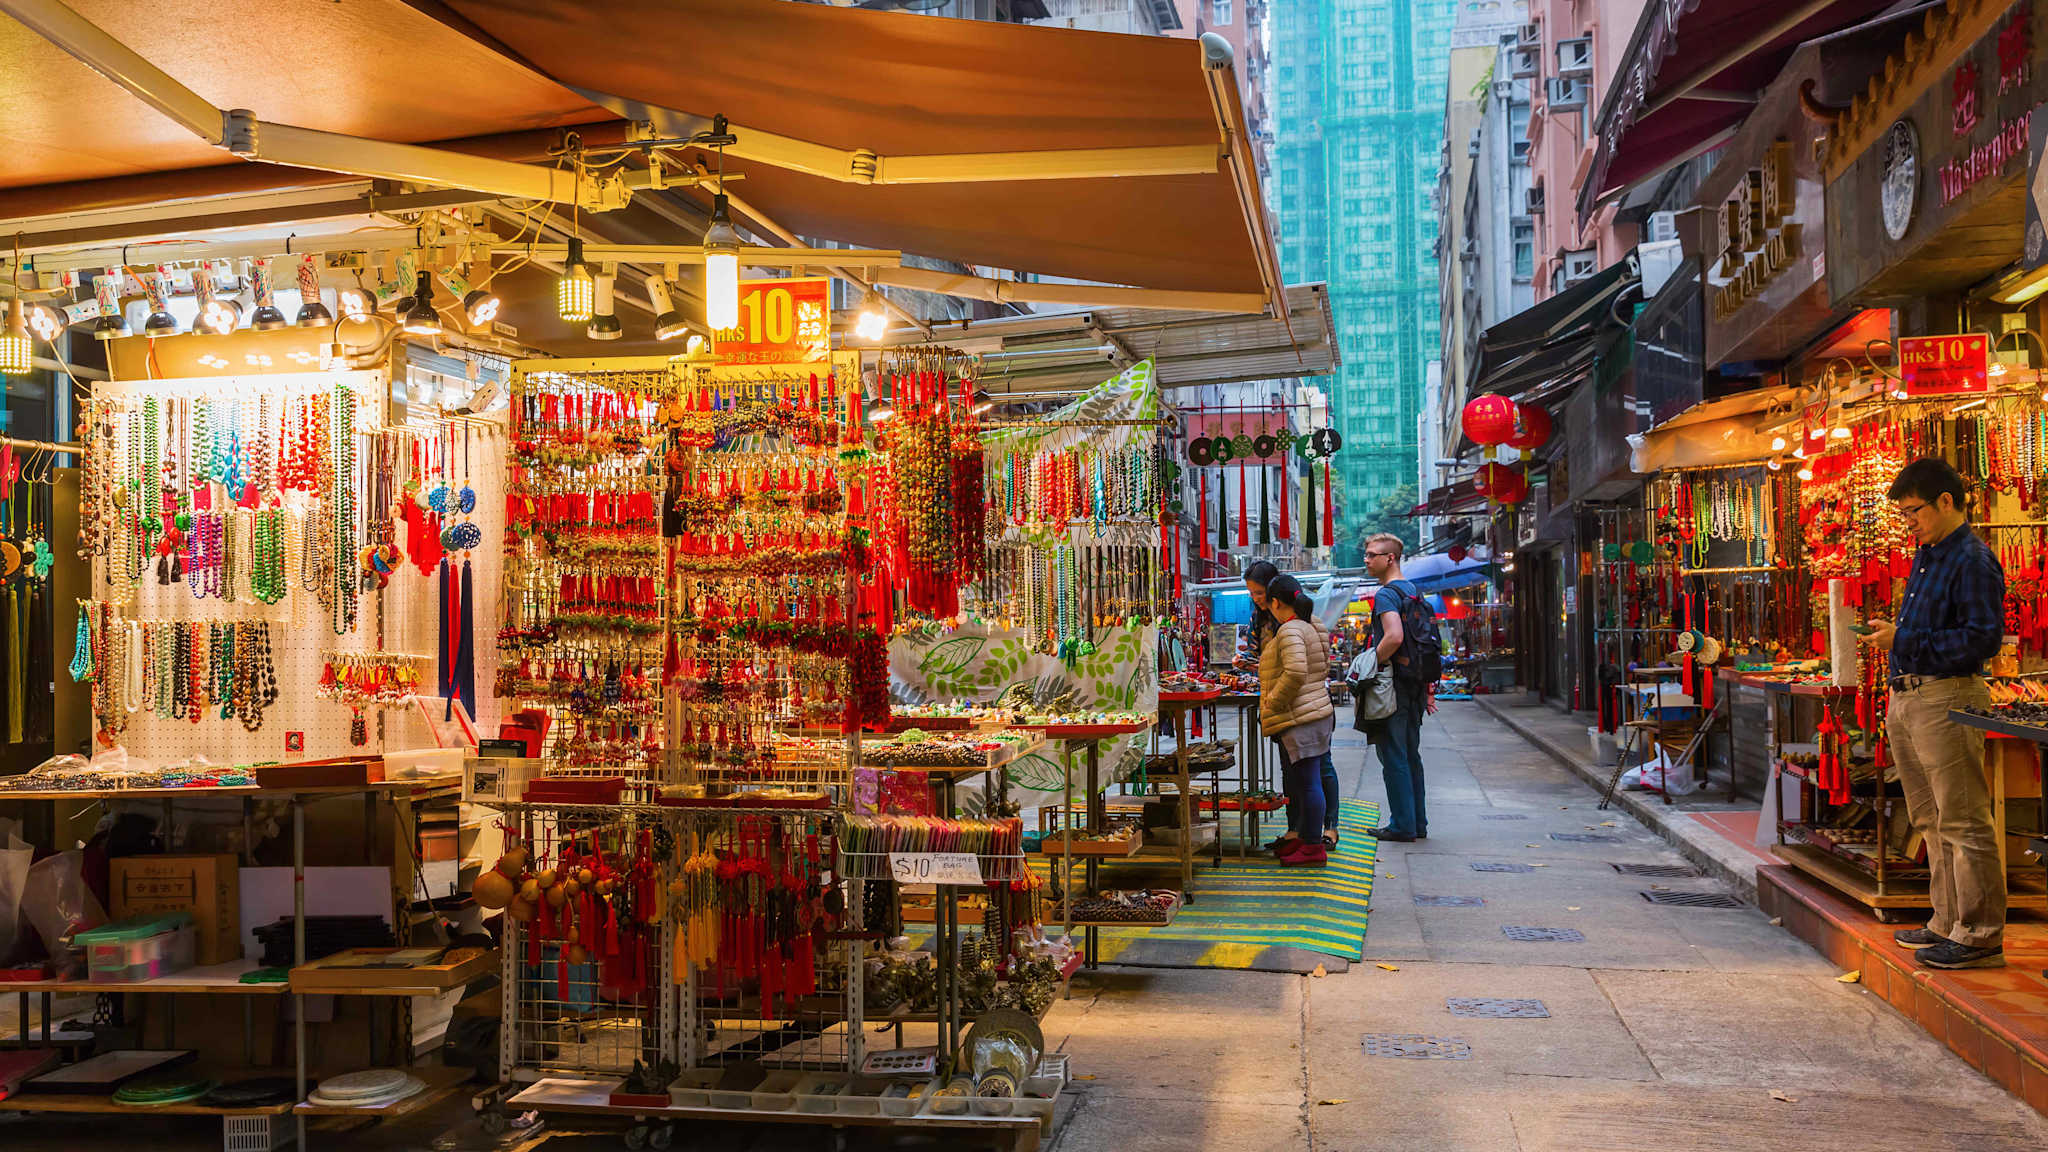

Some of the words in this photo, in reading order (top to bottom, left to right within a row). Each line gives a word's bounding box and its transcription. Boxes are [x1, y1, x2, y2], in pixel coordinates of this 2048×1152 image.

[741, 287, 793, 344] 10
[1936, 340, 1965, 362] 10
[895, 857, 930, 877] $10
